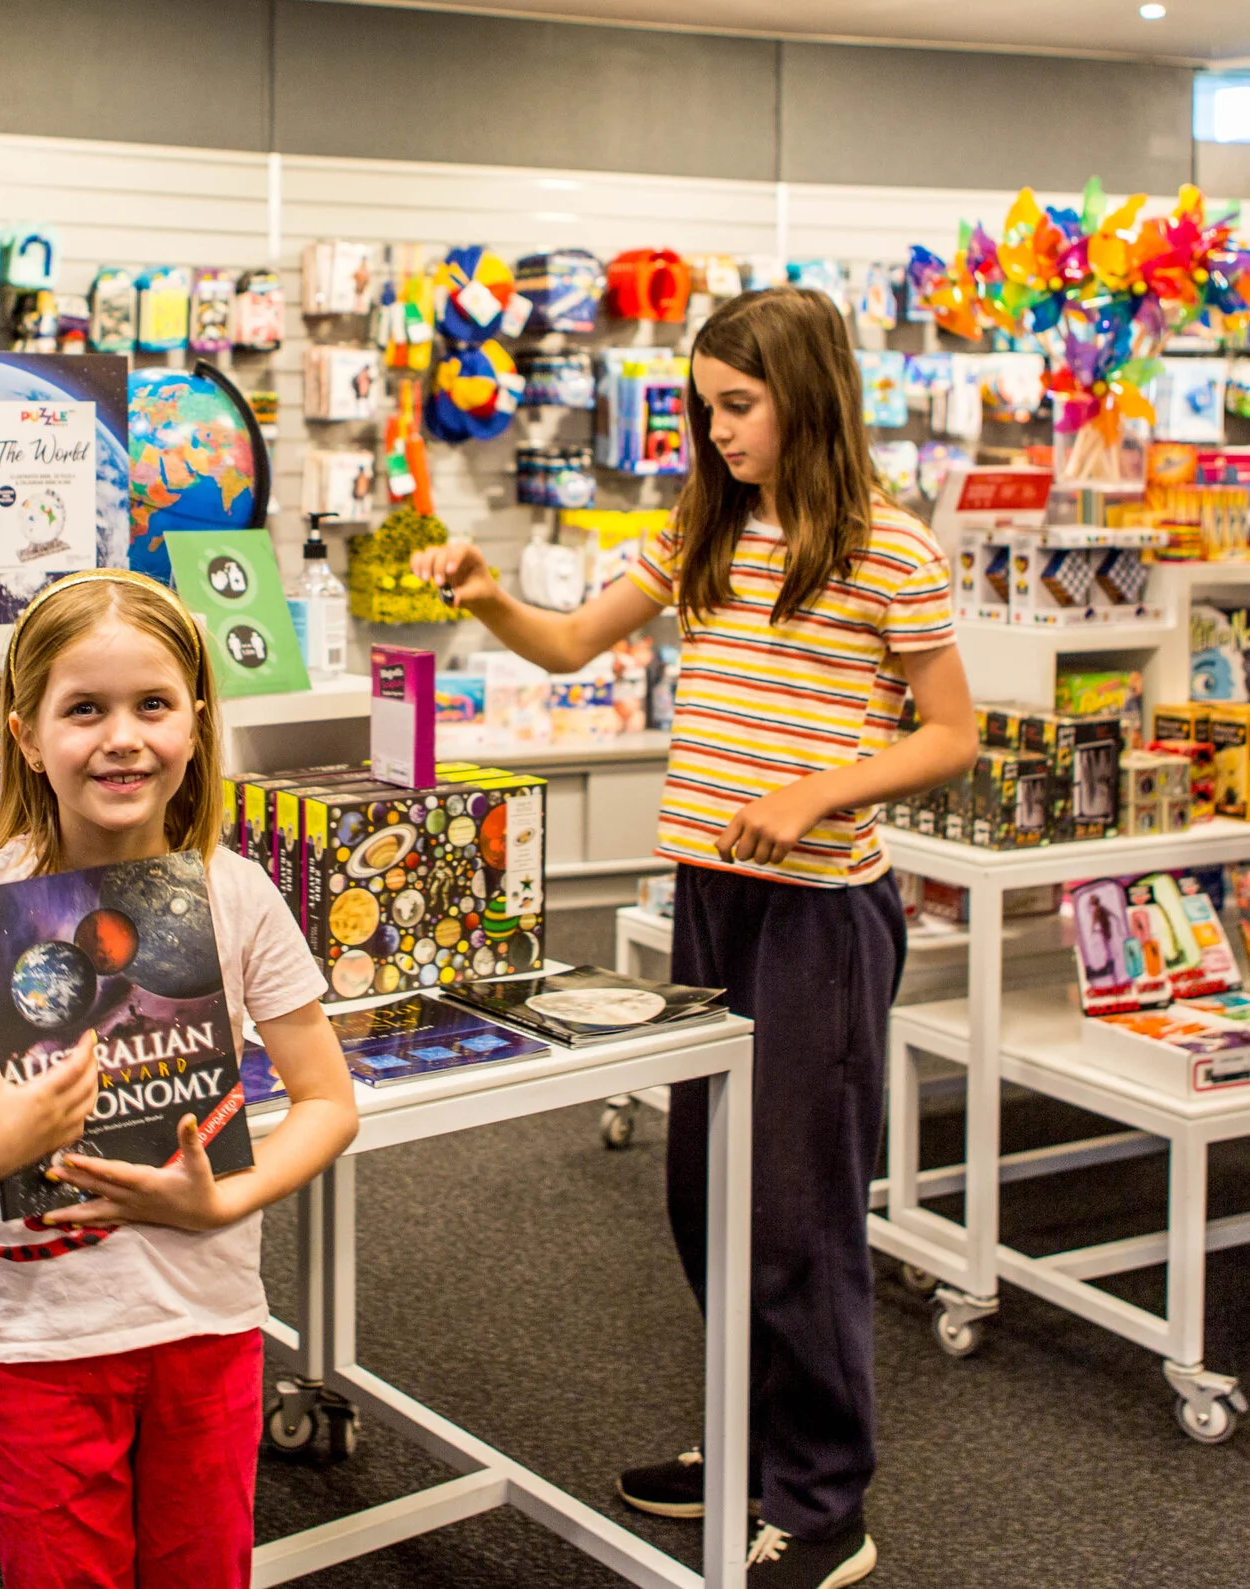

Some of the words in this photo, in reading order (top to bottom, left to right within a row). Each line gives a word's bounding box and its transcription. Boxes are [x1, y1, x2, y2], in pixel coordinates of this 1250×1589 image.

[21, 407, 68, 426] PUZZLE
[30, 434, 91, 464] World
[308, 857, 316, 909] GRAVITY
[4, 1022, 215, 1086] AUSRALIAN
[101, 1057, 188, 1089] KYARD
[86, 1067, 224, 1121] ONOMY
[204, 1098, 238, 1138] UPDATED
